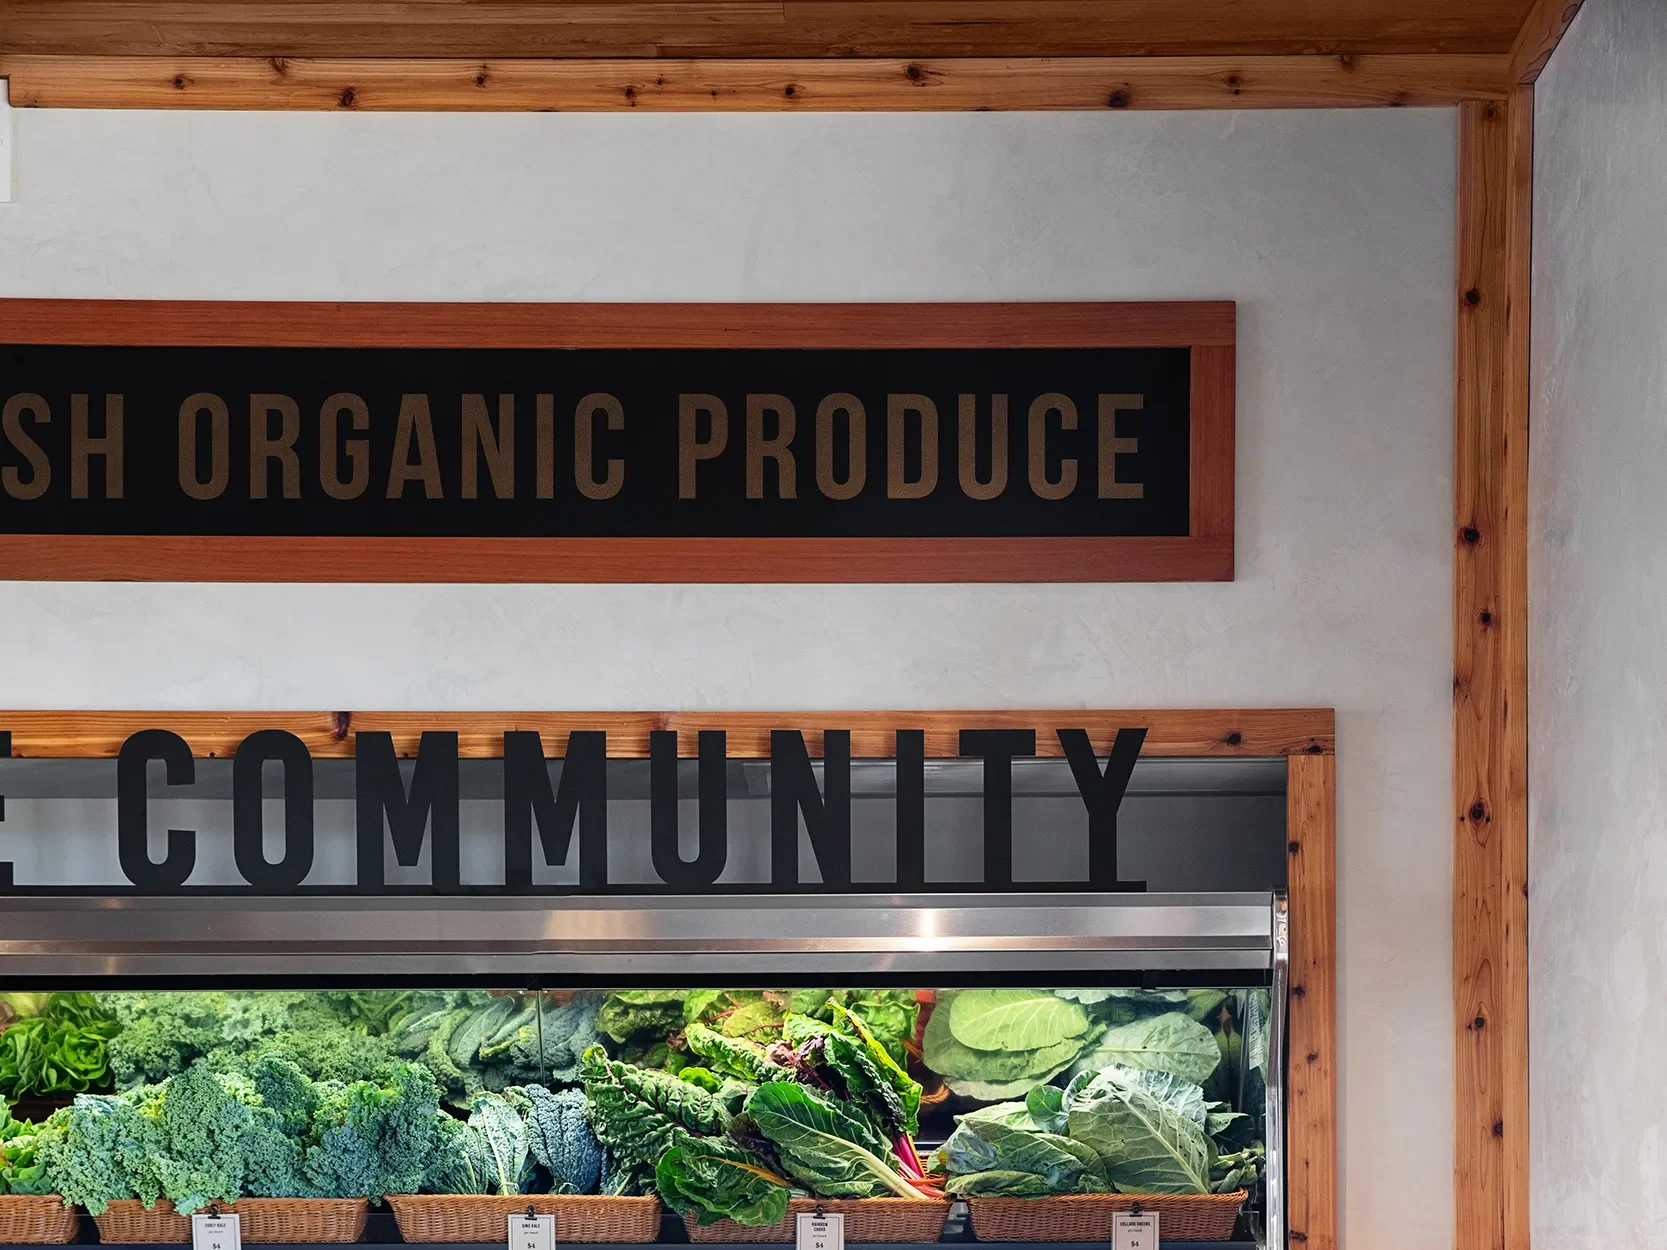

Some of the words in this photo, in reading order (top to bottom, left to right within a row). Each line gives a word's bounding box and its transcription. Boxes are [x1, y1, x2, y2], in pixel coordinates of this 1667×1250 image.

[2, 393, 124, 499] SH
[178, 393, 625, 499] ORGANIC
[679, 393, 1145, 499] PRODUCE
[117, 728, 1149, 890] COMMUNITY
